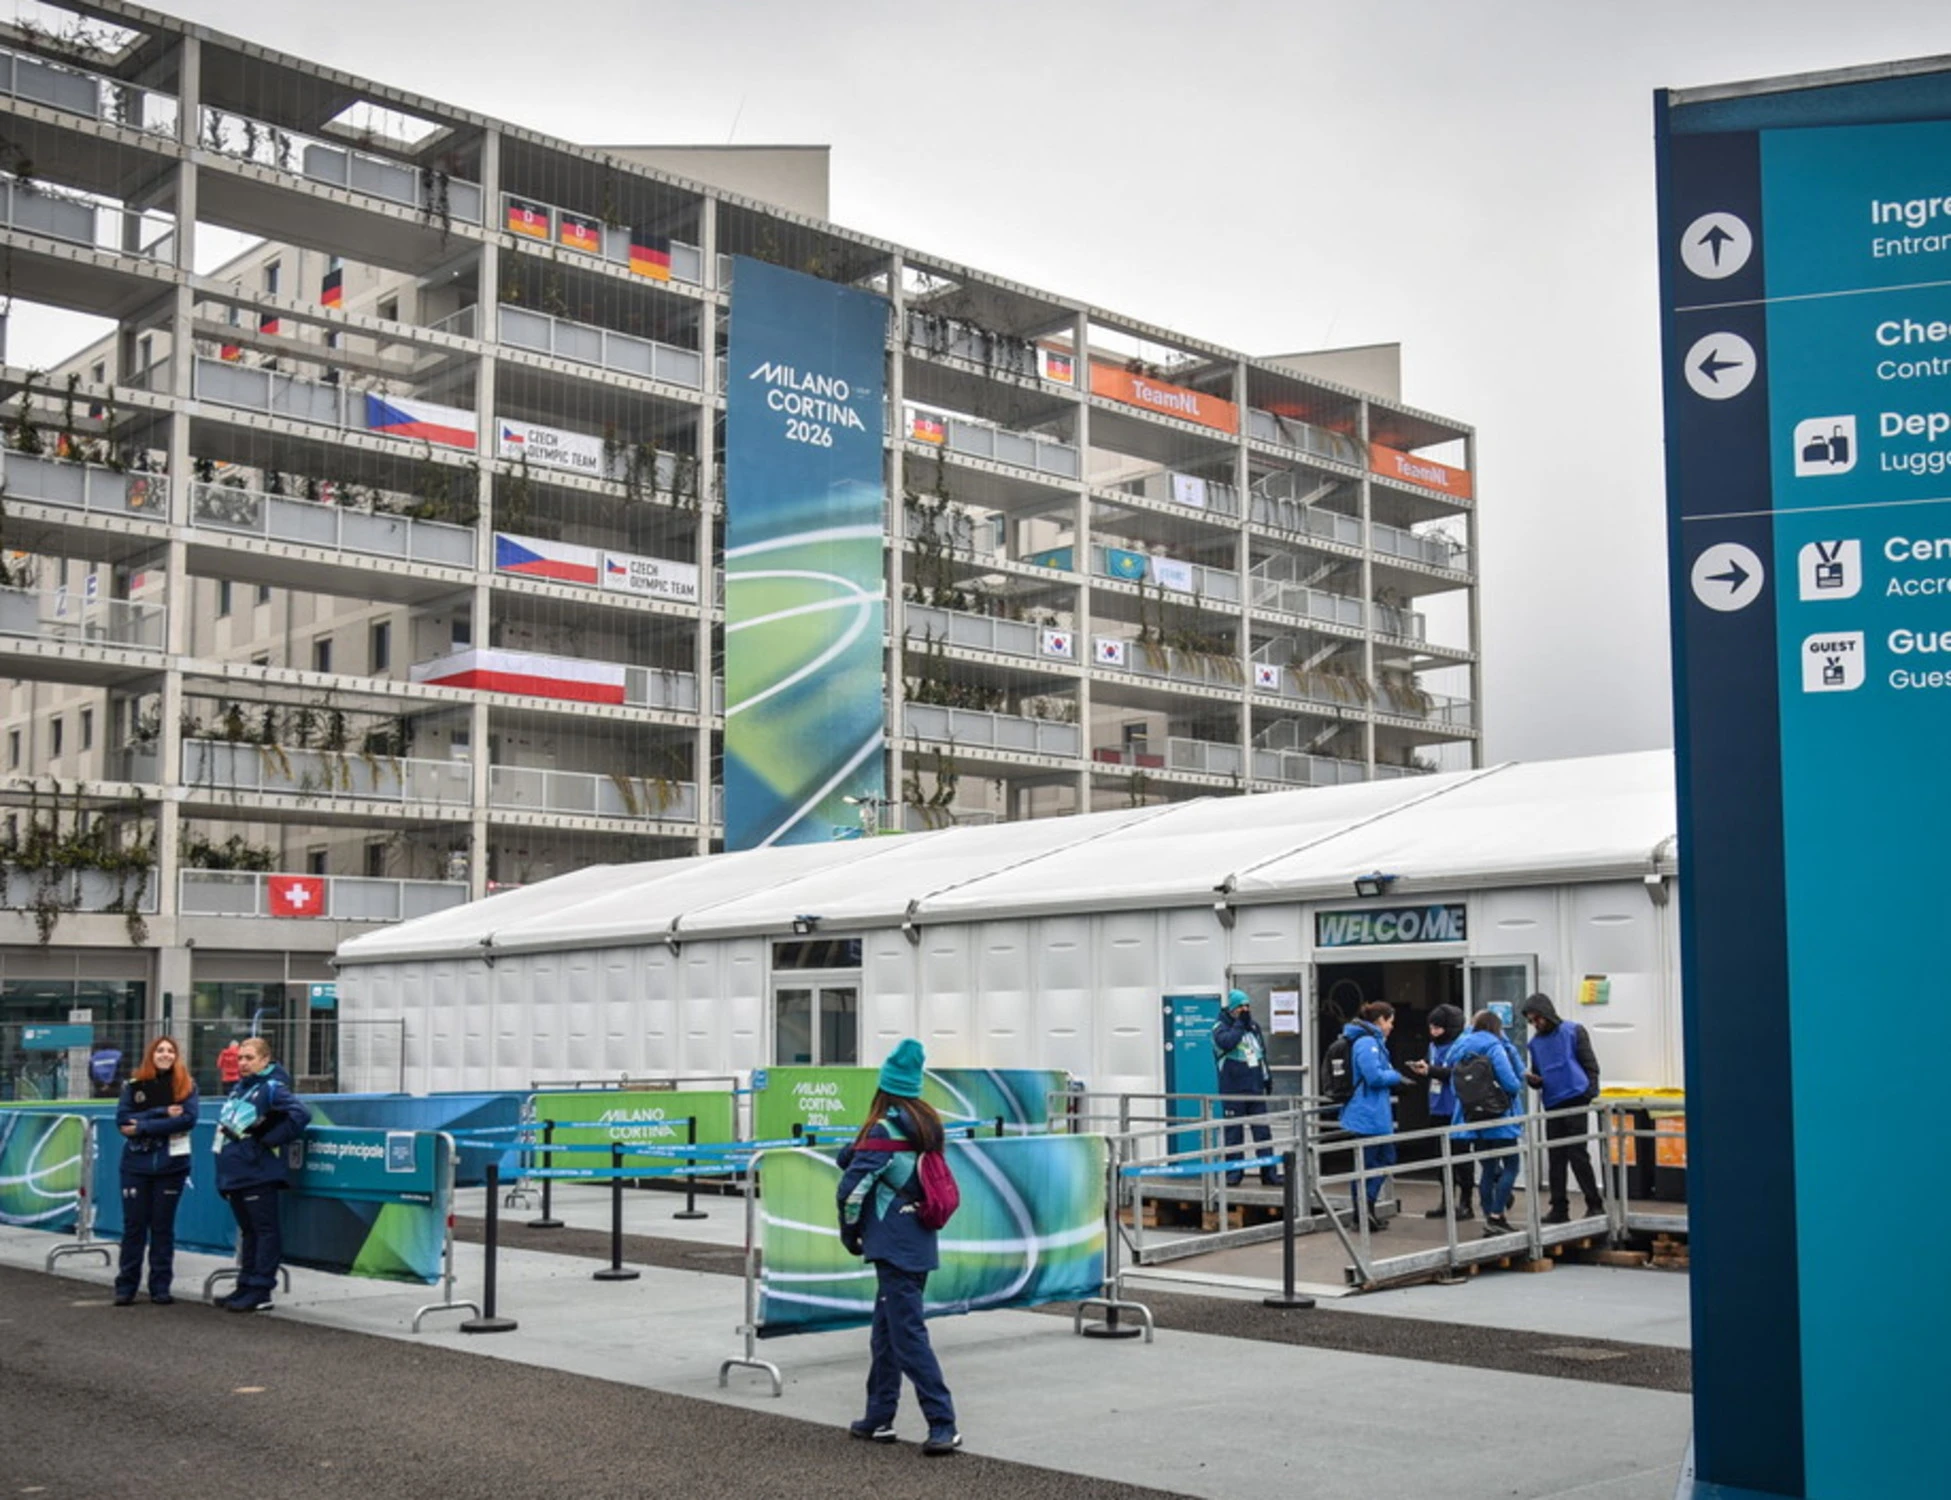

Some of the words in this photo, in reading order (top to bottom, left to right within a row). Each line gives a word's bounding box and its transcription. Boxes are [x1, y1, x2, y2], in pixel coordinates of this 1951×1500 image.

[1876, 318, 1951, 346] Che
[1876, 357, 1951, 380] Contr
[749, 361, 849, 401] MILANO
[1132, 380, 1200, 416] TeamNL
[767, 389, 866, 432] CORTINA
[785, 418, 833, 447] 2026
[1880, 411, 1950, 442] Dep
[528, 429, 558, 447] CZECH
[527, 448, 568, 465] OLYMPIC
[571, 452, 598, 469] TEAM
[1395, 455, 1449, 487] TeamNL
[1884, 536, 1951, 562] Cen
[630, 560, 659, 576] CZECH
[630, 576, 668, 594] OLYMPIC
[670, 581, 695, 596] TEAM
[1886, 577, 1951, 597] Accr
[1810, 640, 1856, 653] GUEST
[1319, 908, 1465, 945] WELCOME
[793, 1082, 839, 1096] MILANO
[599, 1108, 665, 1122] MILANO
[799, 1097, 845, 1112] CORTINA
[609, 1124, 677, 1139] CORTINA
[338, 1140, 384, 1161] principale
